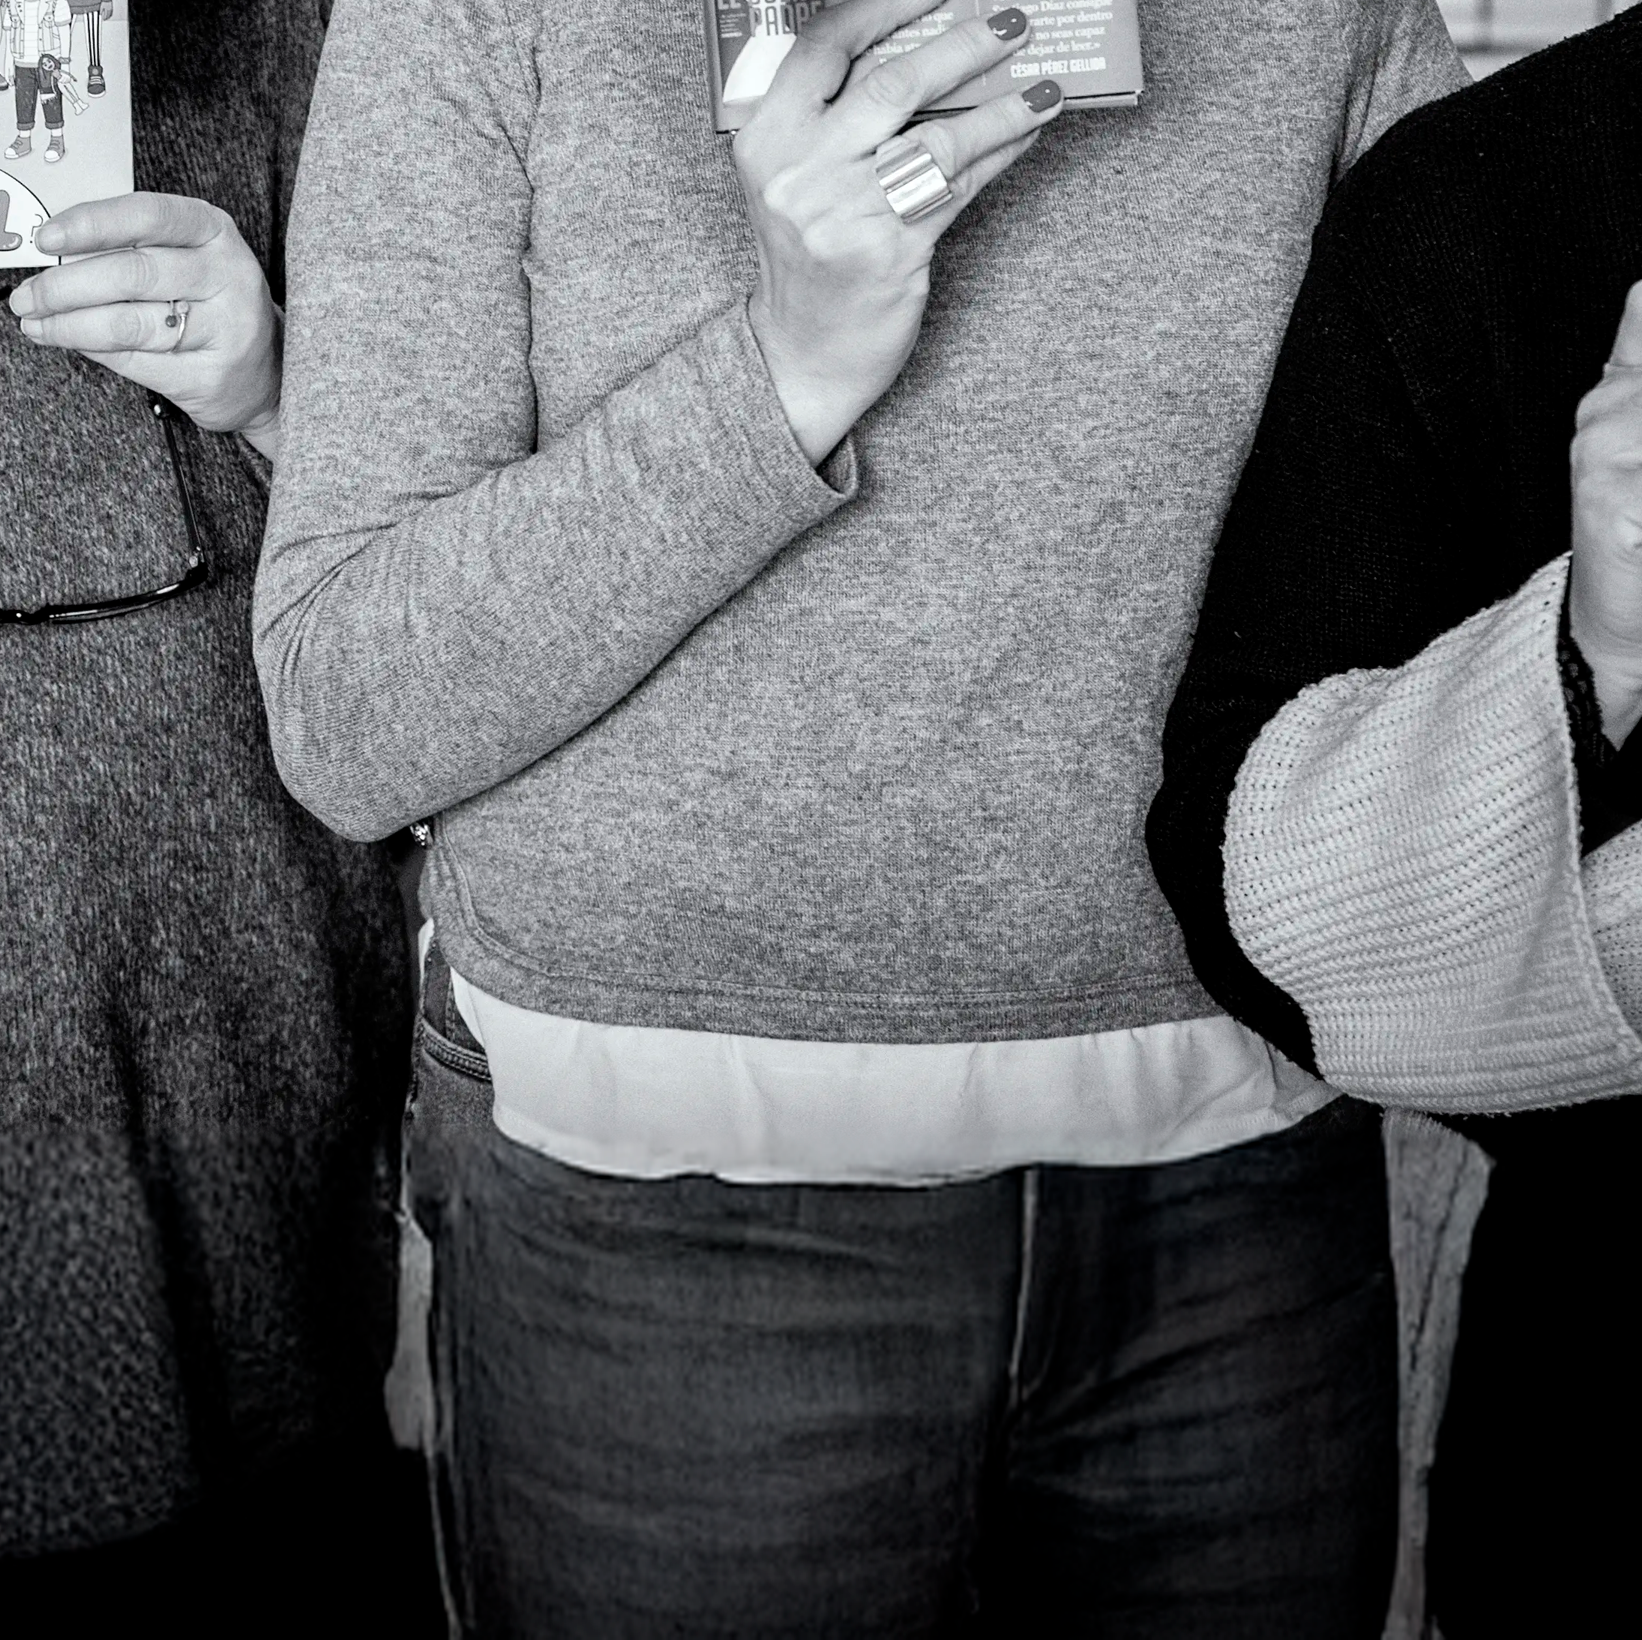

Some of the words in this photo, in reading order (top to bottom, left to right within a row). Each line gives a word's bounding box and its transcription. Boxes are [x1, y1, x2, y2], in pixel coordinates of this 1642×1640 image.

[1057, 15, 1076, 27] por
[1077, 11, 1113, 22] dentro
[1035, 31, 1050, 40] no
[1075, 26, 1106, 39] capaz
[1027, 44, 1056, 57] dejar
[1057, 42, 1070, 53] de
